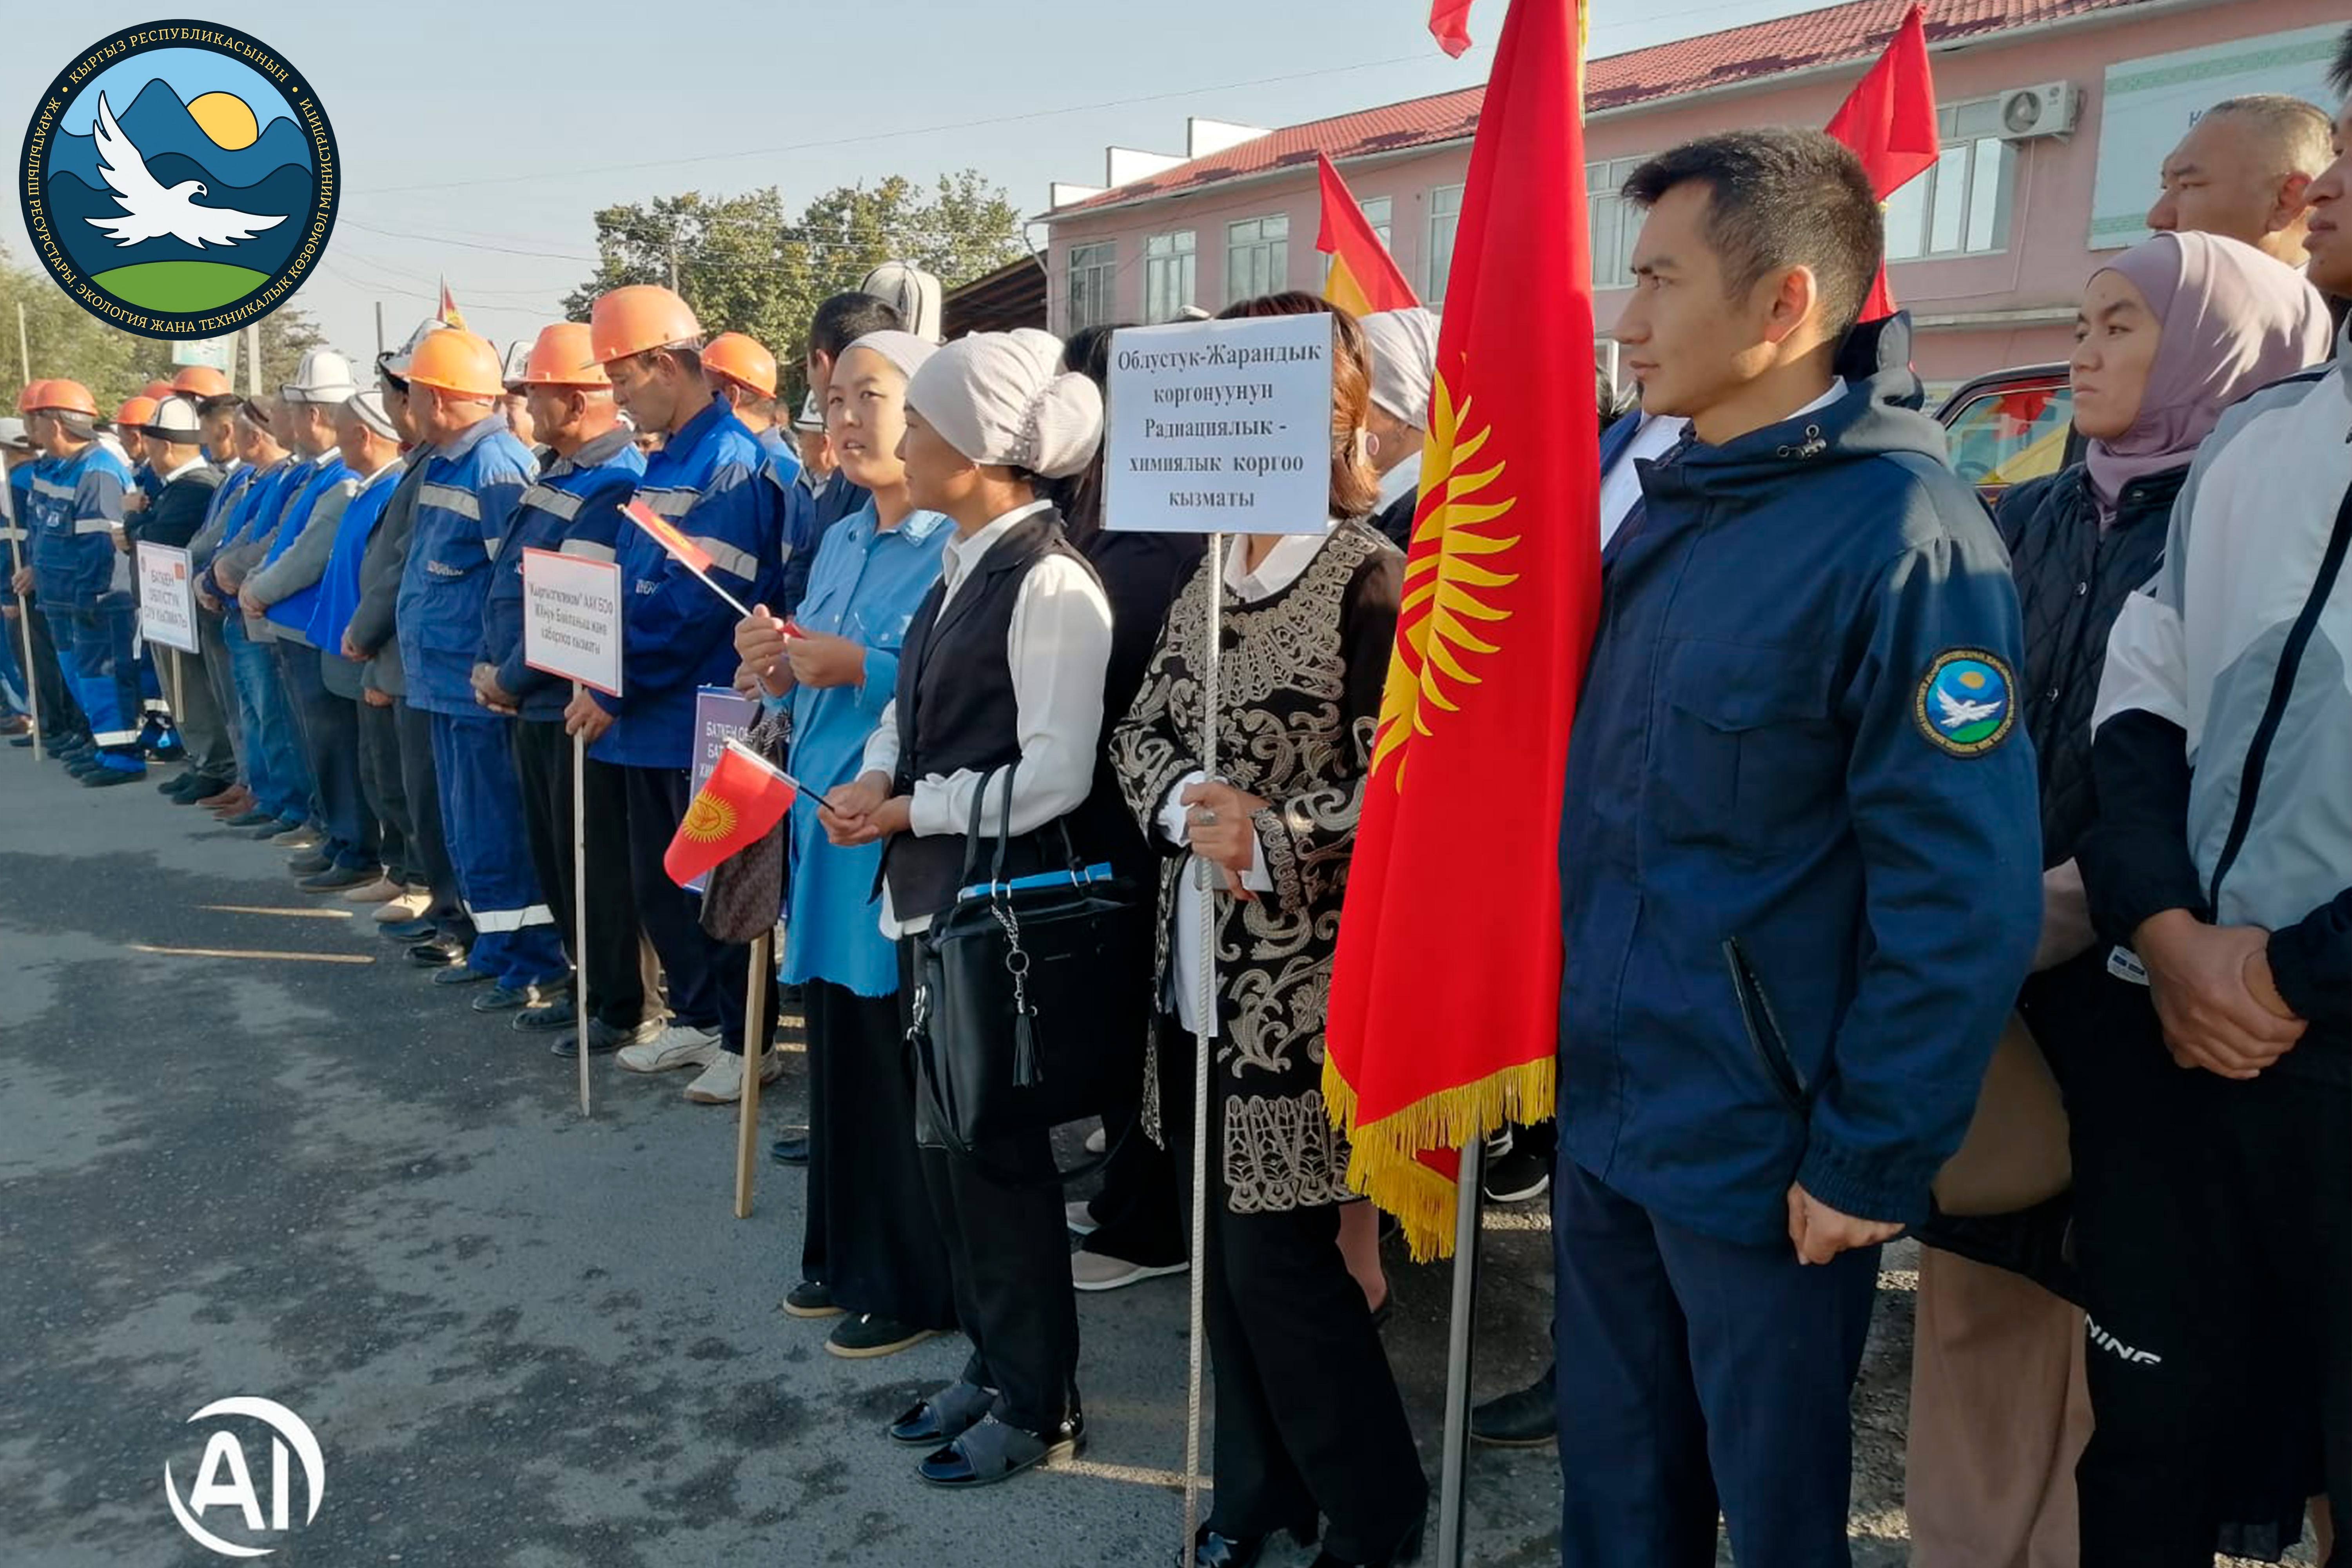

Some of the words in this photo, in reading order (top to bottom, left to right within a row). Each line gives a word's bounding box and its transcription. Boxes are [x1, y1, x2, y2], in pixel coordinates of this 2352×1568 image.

[1118, 344, 1321, 373] Облустук-Жарандык
[1154, 383, 1273, 407] коргонуунун
[1145, 418, 1273, 439] Радиациялык
[1129, 456, 1222, 472] химиялык
[1234, 455, 1304, 477] коргоо
[1169, 491, 1255, 507] кызматы
